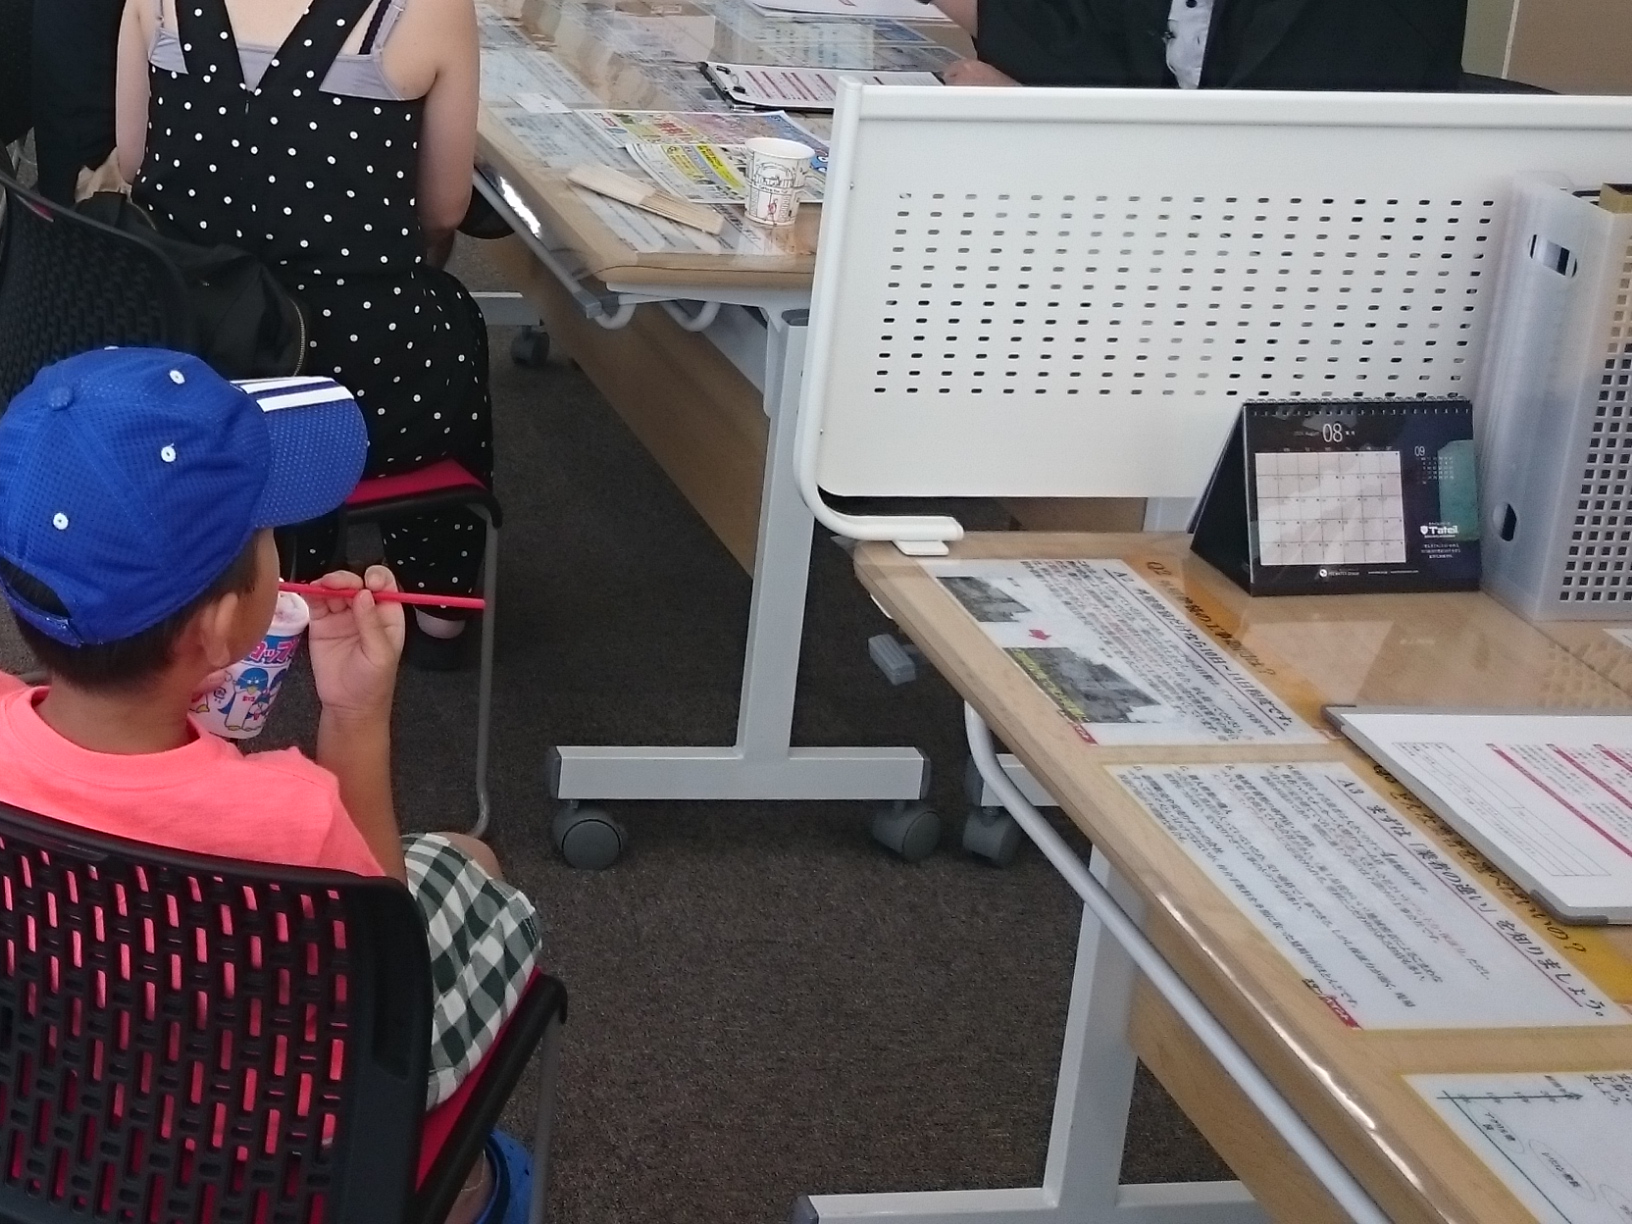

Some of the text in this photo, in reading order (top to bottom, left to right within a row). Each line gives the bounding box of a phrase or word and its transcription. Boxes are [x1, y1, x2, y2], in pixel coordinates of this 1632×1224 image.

[1322, 422, 1343, 443] 08
[1414, 445, 1426, 457] 09
[1147, 560, 1172, 577] Q2
[1337, 777, 1363, 795] A3
[1365, 803, 1606, 1019] まずは「業者の違い」を知りましょう。
